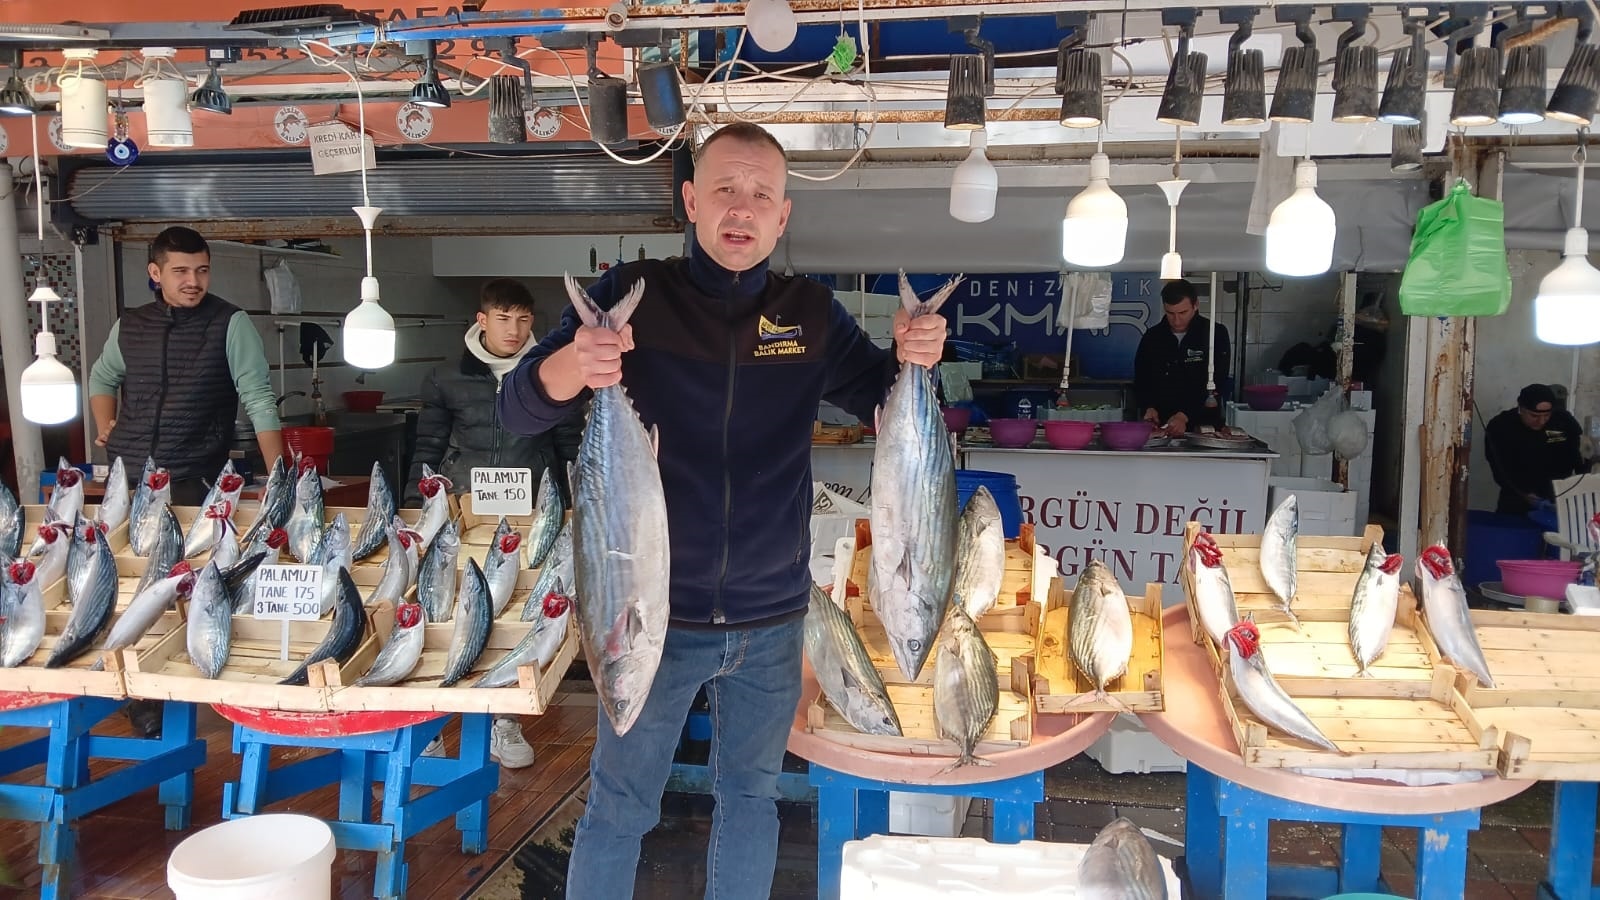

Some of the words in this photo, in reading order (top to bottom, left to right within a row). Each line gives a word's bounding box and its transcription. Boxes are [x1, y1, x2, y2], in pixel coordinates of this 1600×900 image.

[313, 132, 336, 143] KREDİ
[754, 348, 777, 357] BALIK
[777, 346, 807, 355] MARKET
[758, 340, 799, 351] BANDIRMA
[474, 471, 528, 484] PALAMUT
[503, 488, 526, 500] 150
[1019, 490, 1122, 533] RGÜN
[259, 568, 321, 582] PALAMUT
[258, 586, 289, 598] TANE
[295, 586, 317, 600] 175
[257, 602, 264, 614] 3
[293, 602, 319, 615] 500
